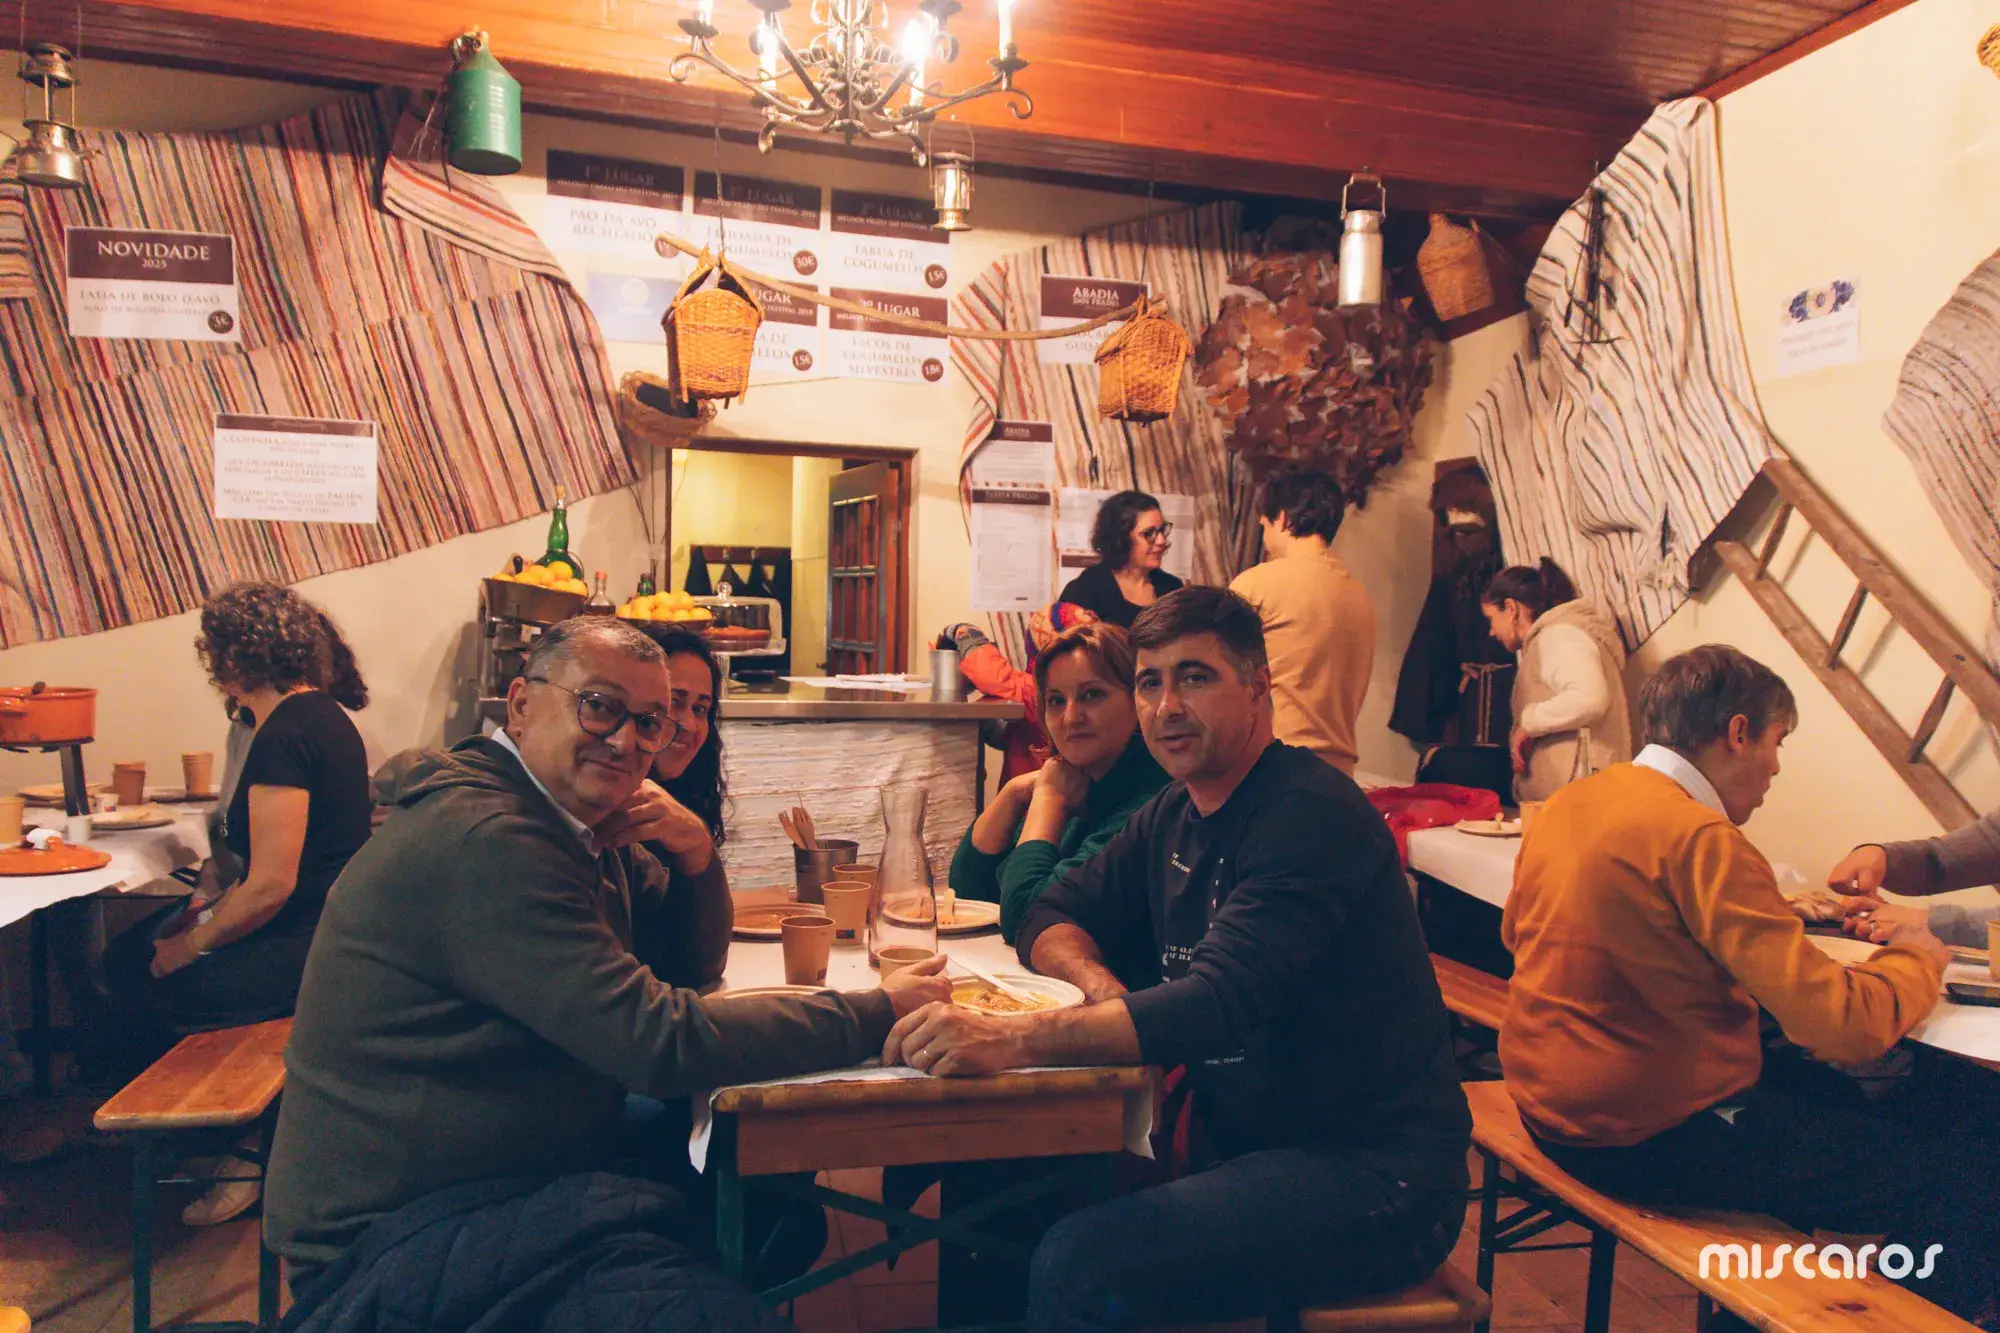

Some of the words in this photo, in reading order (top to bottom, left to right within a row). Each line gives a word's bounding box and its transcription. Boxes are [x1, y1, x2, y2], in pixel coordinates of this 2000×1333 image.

[604, 211, 623, 225] DA
[97, 240, 210, 261] NOVIDADE
[899, 248, 914, 260] DE
[843, 256, 924, 274] COGUMELOS
[121, 291, 137, 301] DE
[142, 292, 177, 304] BOLO
[752, 288, 793, 305] UGAR
[1072, 286, 1120, 300] ABADIA
[877, 301, 921, 318] LUGAR
